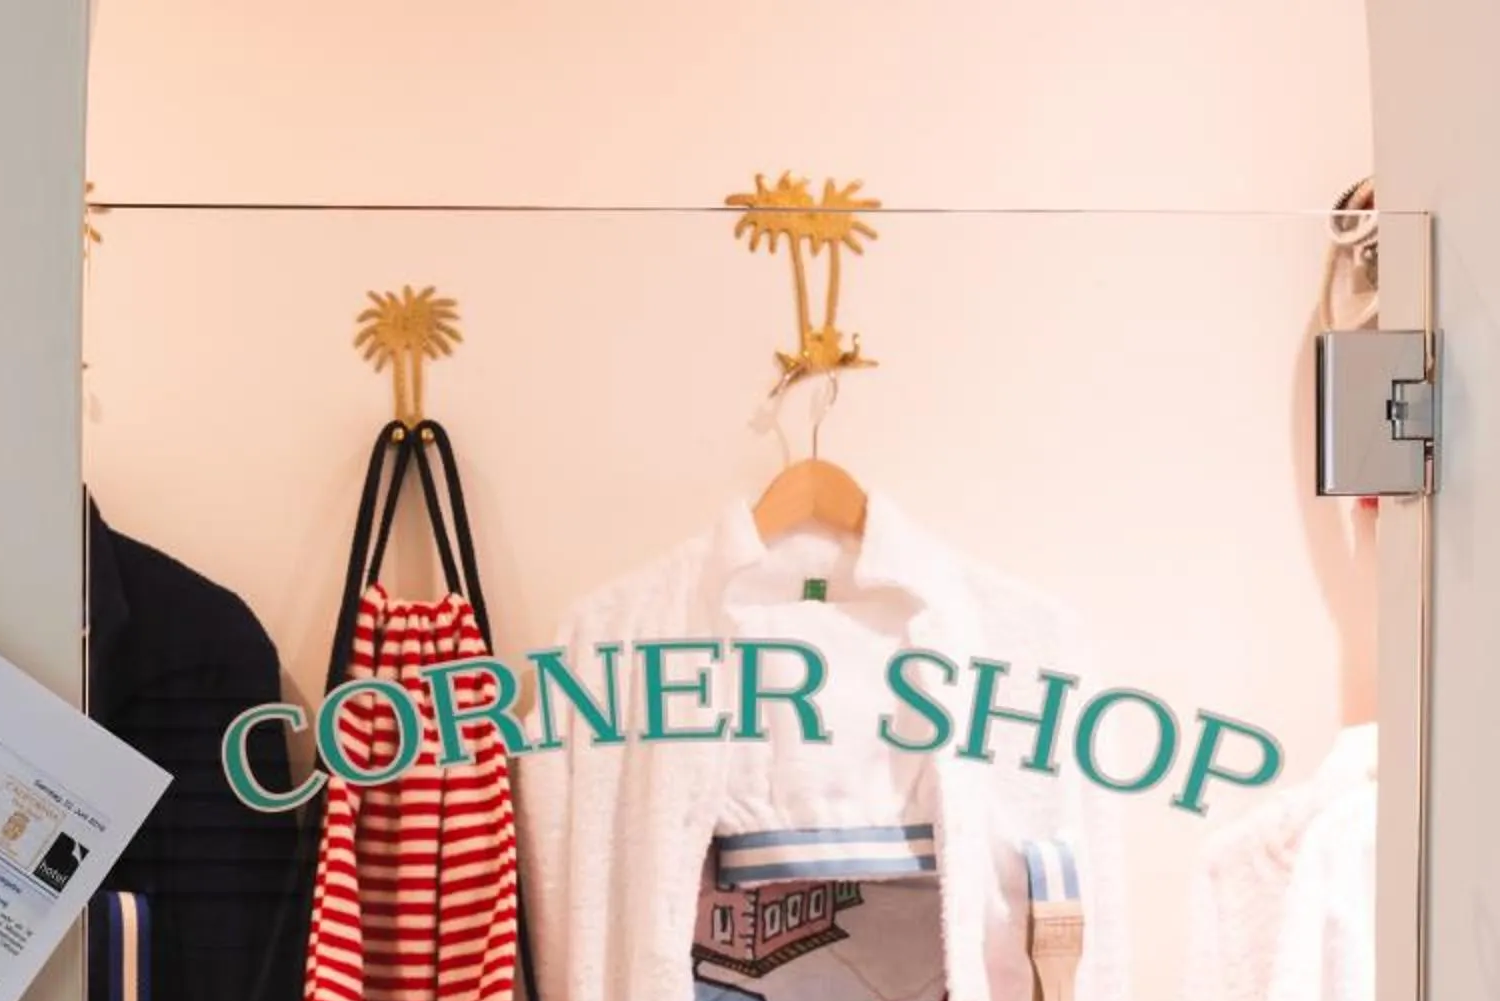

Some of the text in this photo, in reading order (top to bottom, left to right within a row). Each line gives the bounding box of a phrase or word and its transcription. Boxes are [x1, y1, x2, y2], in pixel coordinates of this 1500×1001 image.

[221, 637, 1285, 816] CORNER SHOP
[37, 859, 69, 886] hotel
